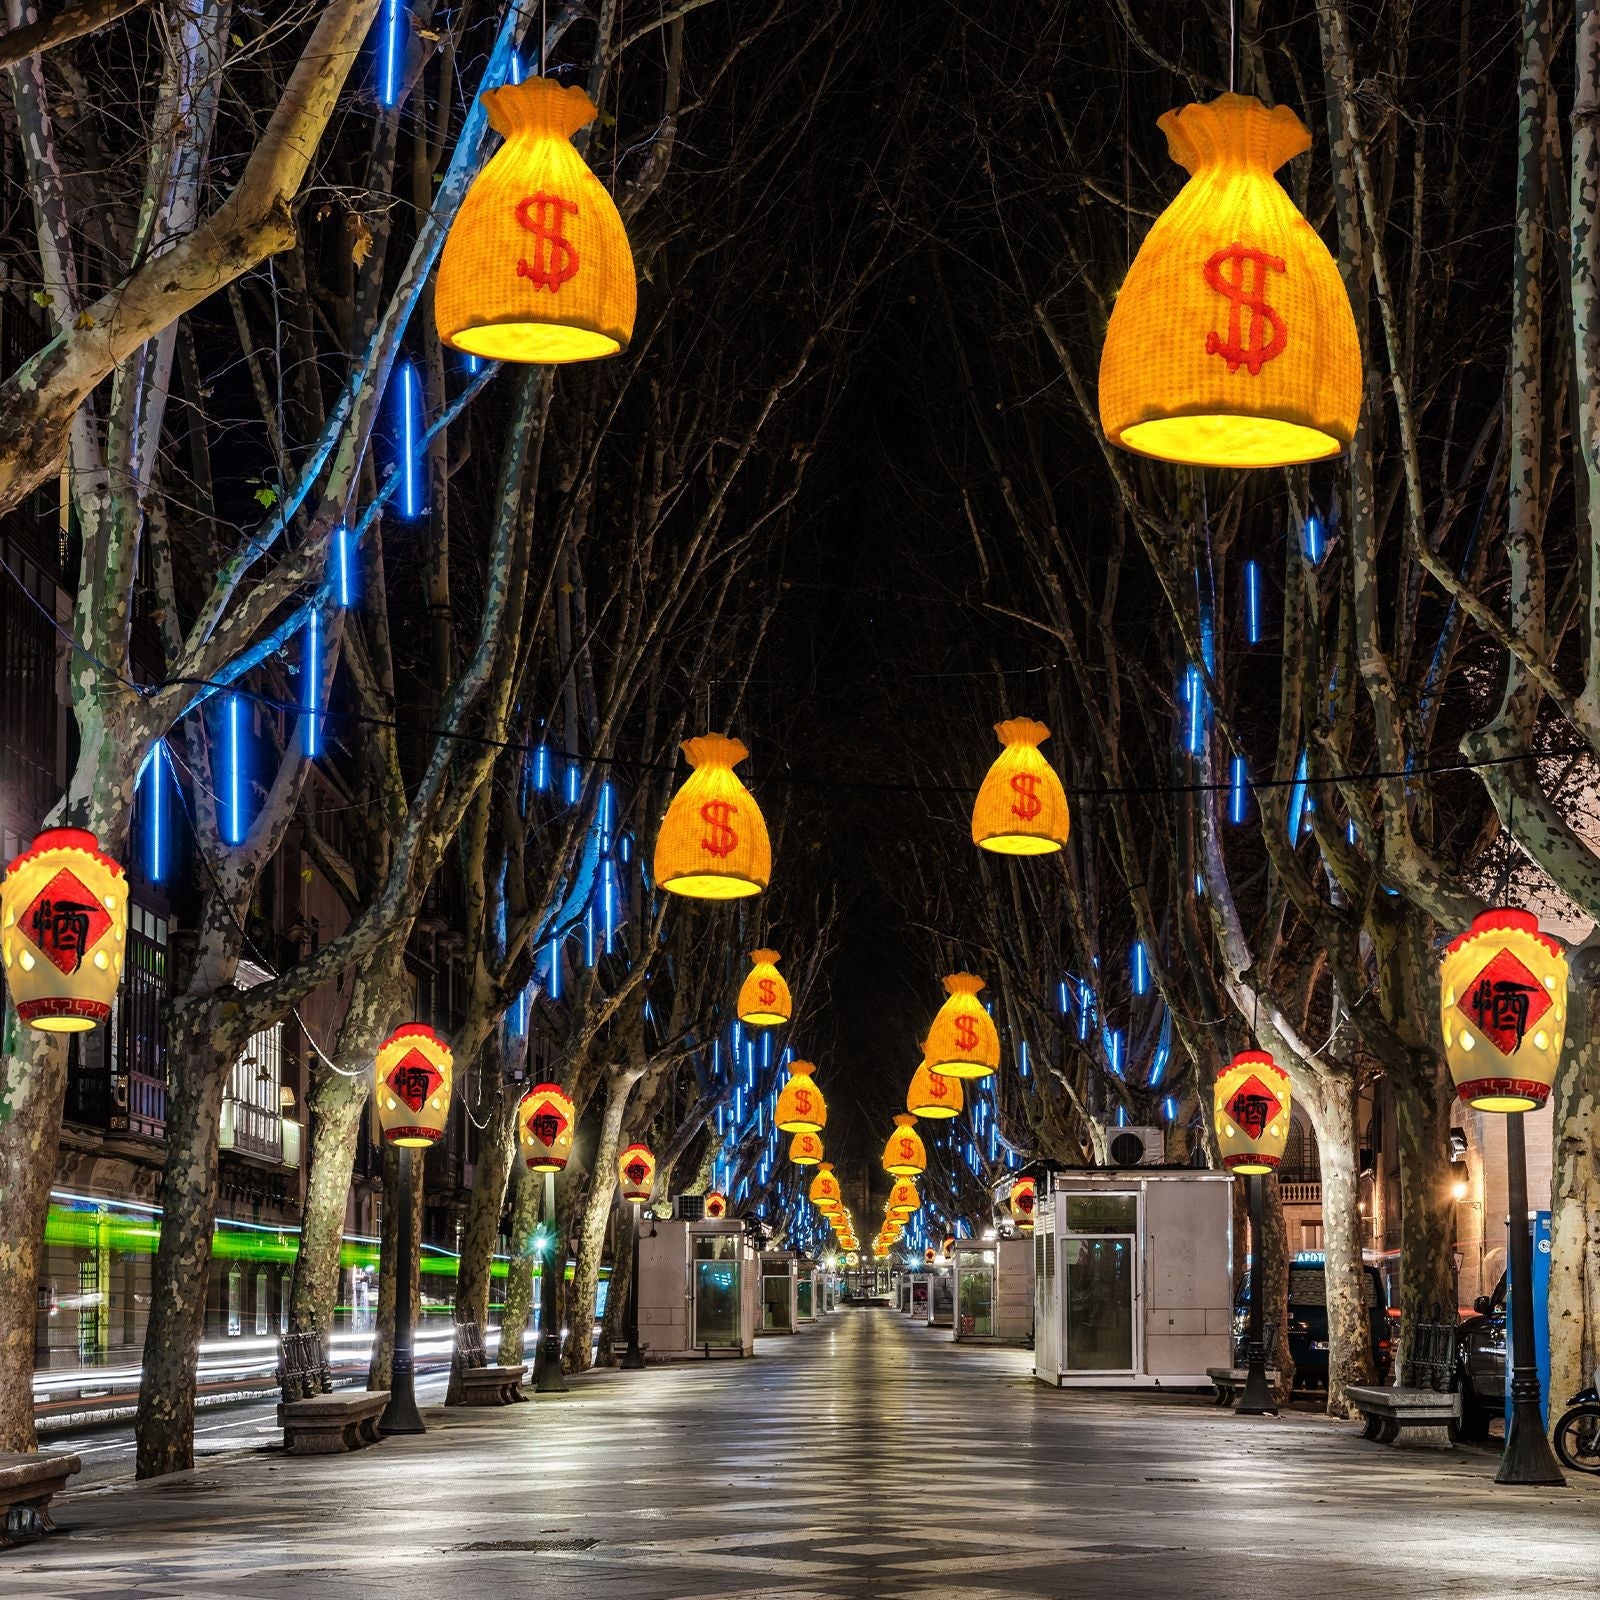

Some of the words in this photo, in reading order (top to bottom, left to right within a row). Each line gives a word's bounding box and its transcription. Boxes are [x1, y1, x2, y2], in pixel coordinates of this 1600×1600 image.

[515, 190, 580, 293] $
[1203, 242, 1288, 376] $
[1010, 772, 1042, 822] $
[701, 799, 739, 859] $
[32, 899, 100, 976] 酒
[758, 979, 777, 1006] $
[954, 1014, 980, 1052] $
[1472, 979, 1539, 1056] 酒
[394, 1067, 436, 1113] 酒
[794, 1089, 813, 1115] $
[1233, 1093, 1275, 1140] 酒
[802, 1136, 814, 1153] $
[900, 1138, 915, 1160] $
